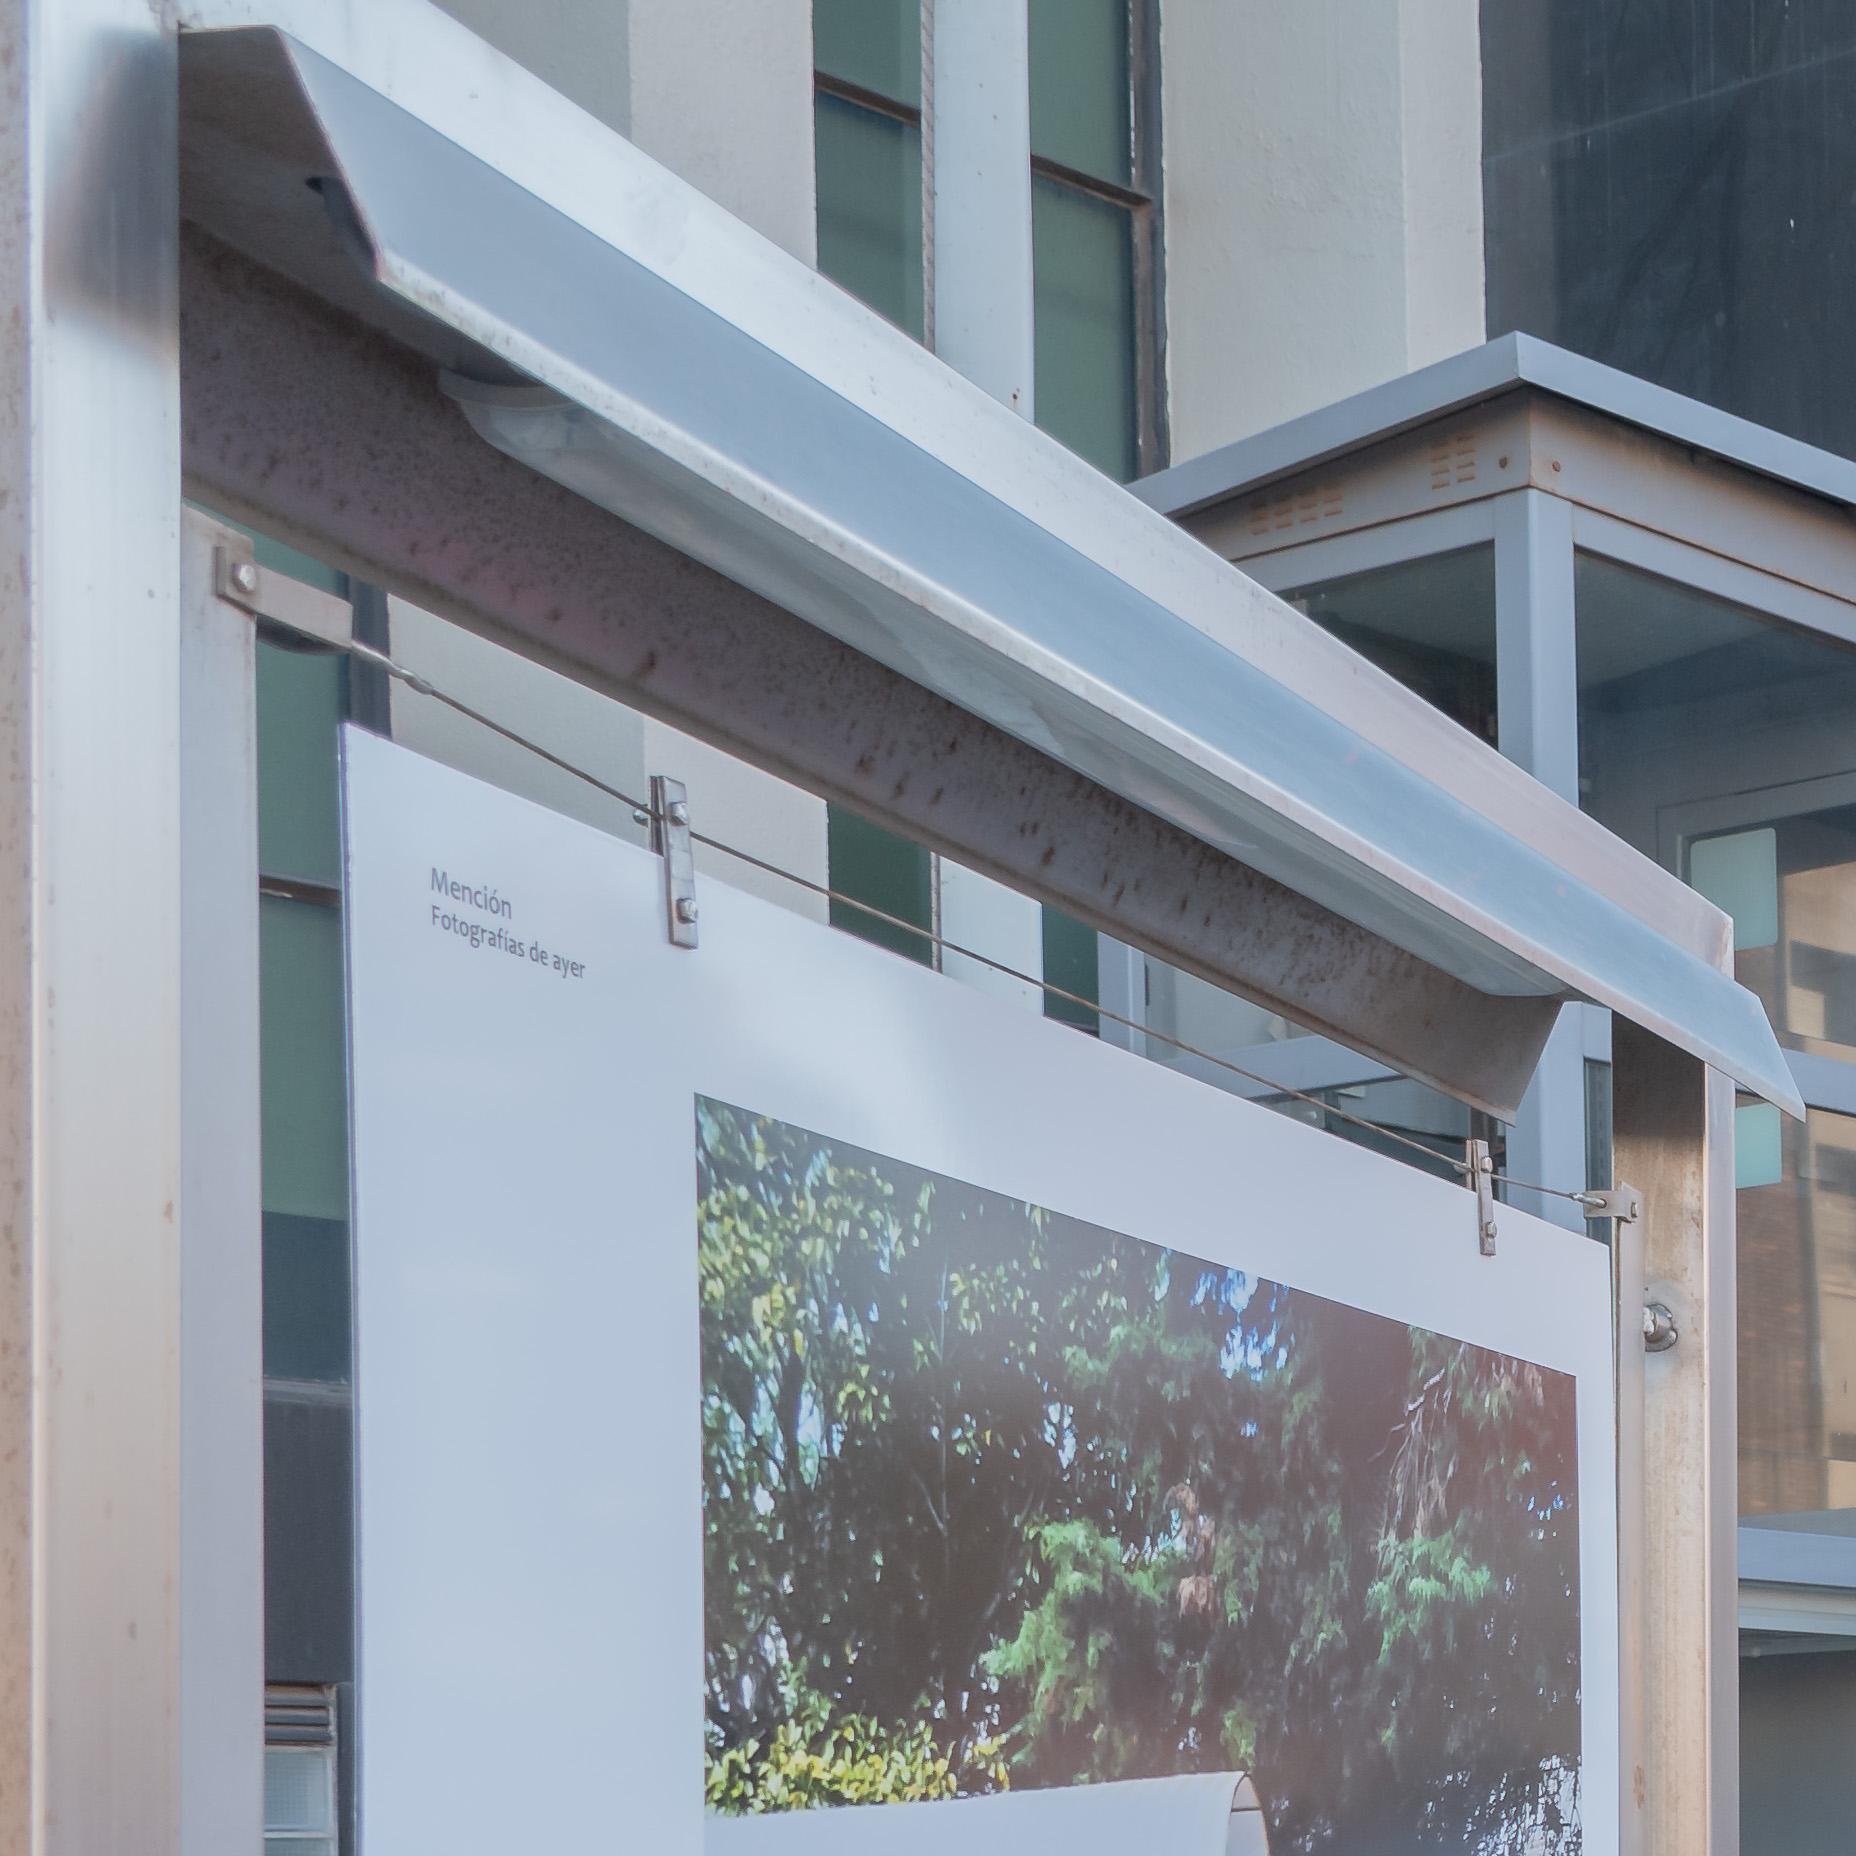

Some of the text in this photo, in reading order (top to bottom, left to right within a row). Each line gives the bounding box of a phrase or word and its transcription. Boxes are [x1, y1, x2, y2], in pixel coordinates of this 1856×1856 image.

[430, 868, 512, 919] Mención
[431, 905, 586, 979] Fotografías de ayer
